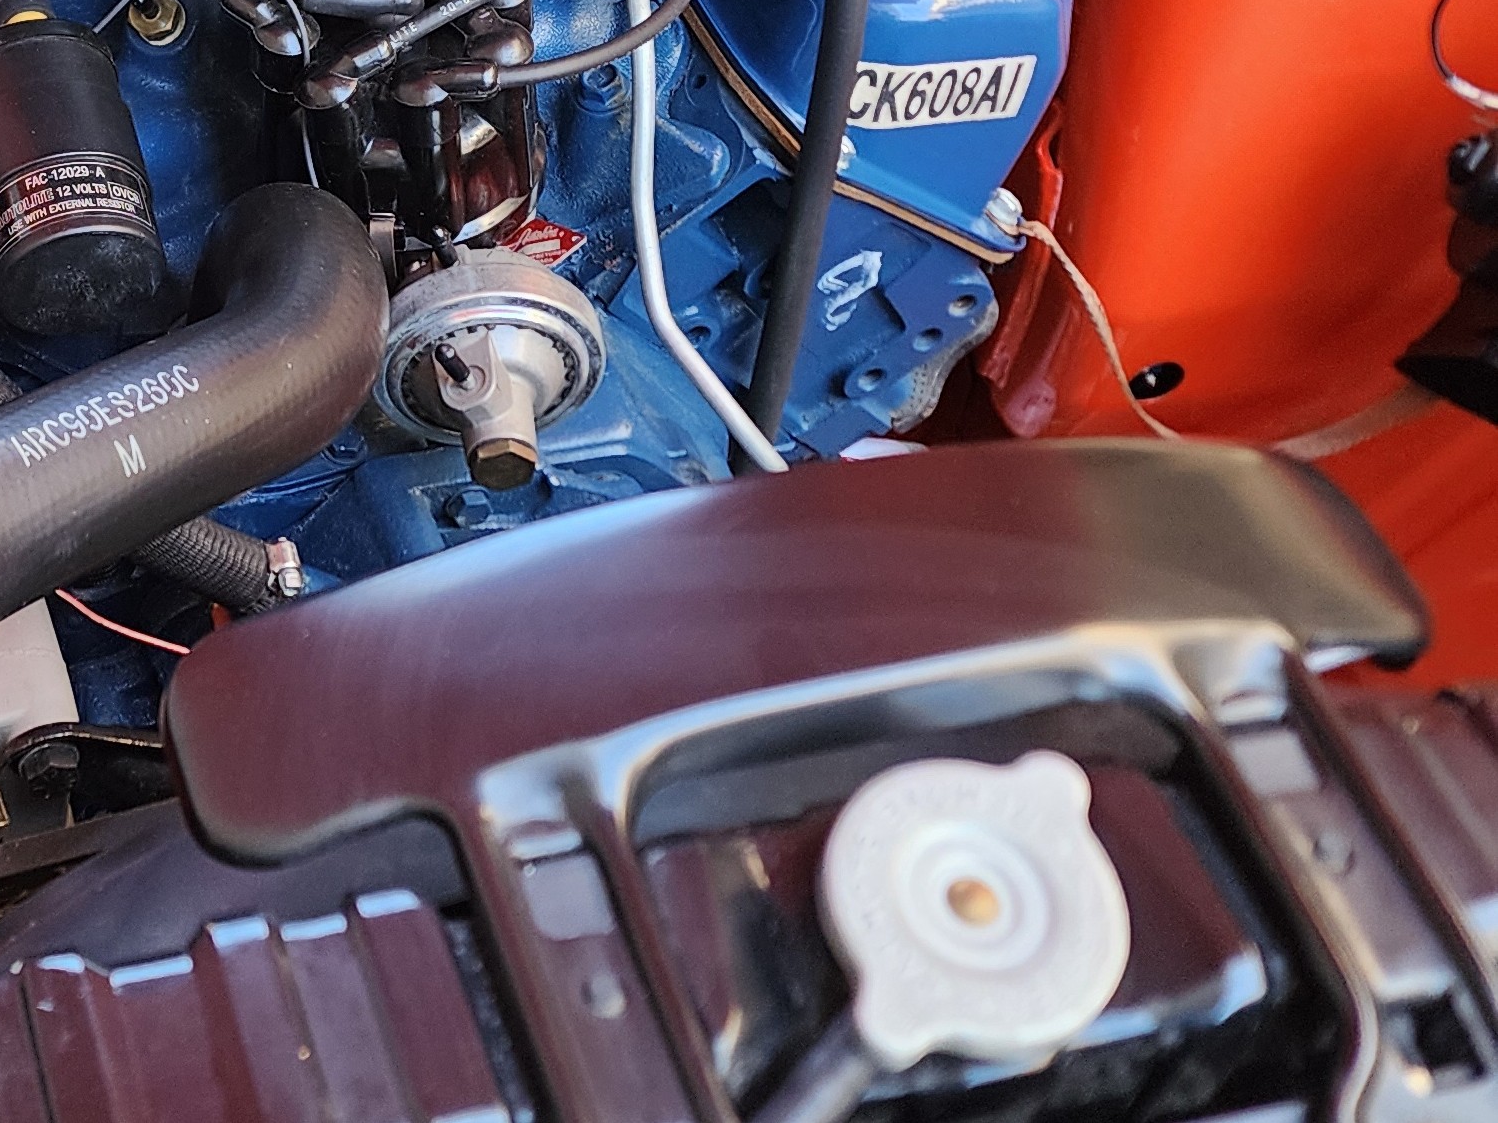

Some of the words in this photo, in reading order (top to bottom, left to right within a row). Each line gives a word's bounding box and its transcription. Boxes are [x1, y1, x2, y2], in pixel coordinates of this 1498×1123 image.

[56, 185, 73, 197] 12
[72, 182, 108, 195] VOLTS
[7, 221, 23, 236] USE
[24, 207, 48, 226] WITH
[48, 198, 97, 214] EXTERNAL
[96, 198, 137, 214] RESISTOR
[113, 434, 147, 478] M
